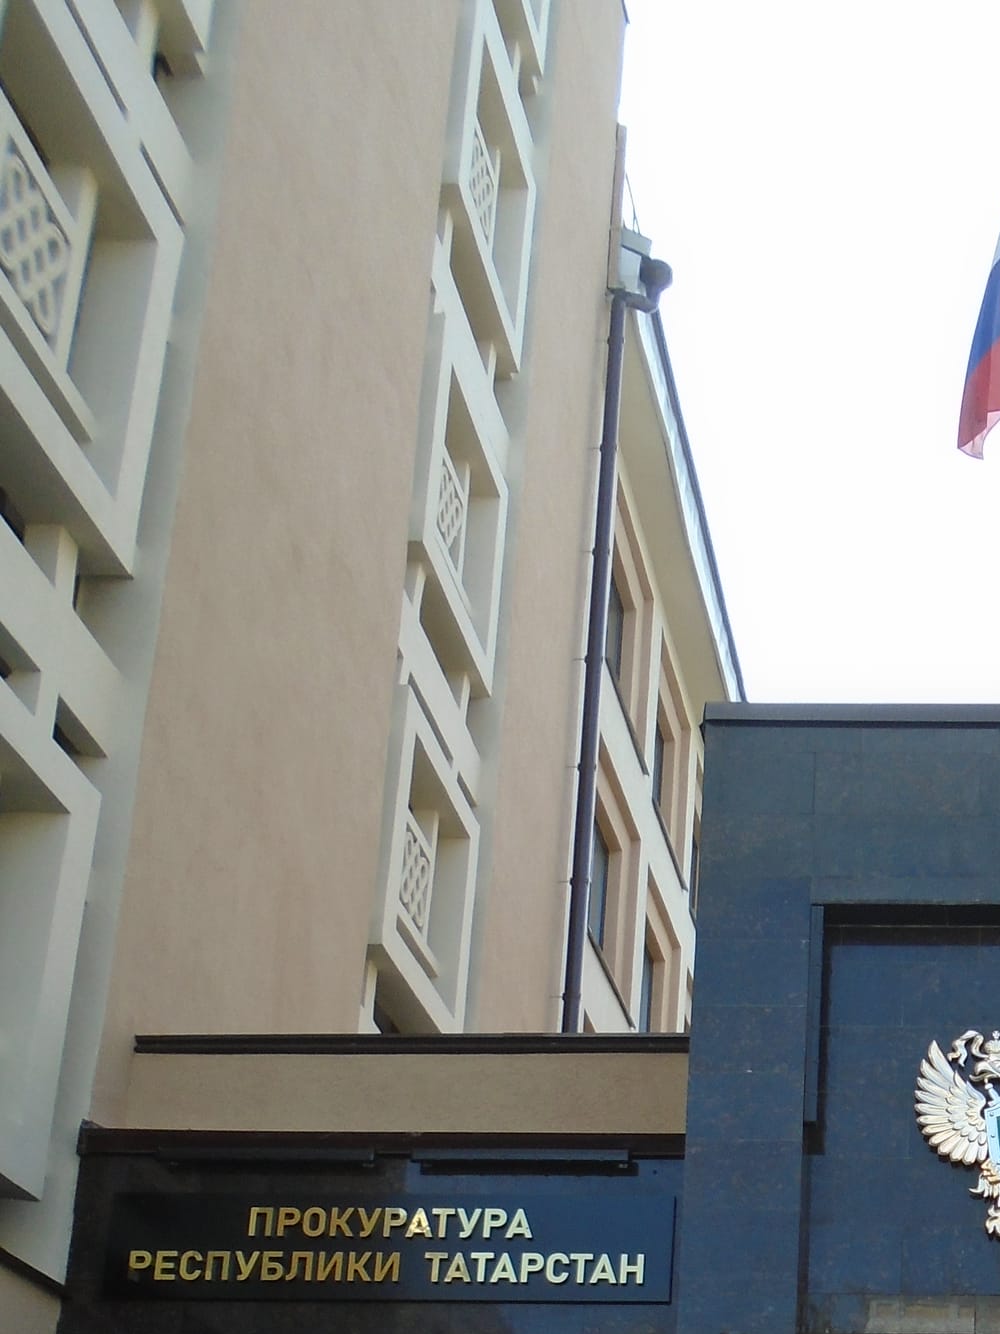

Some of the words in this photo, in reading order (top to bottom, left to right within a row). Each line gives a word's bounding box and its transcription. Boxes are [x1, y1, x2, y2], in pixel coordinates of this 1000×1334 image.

[246, 1206, 533, 1239] ПРОКУРАТУРА
[128, 1251, 401, 1284] РЕСПУБЛИКИ
[425, 1251, 645, 1285] ТАТАРСТАН
